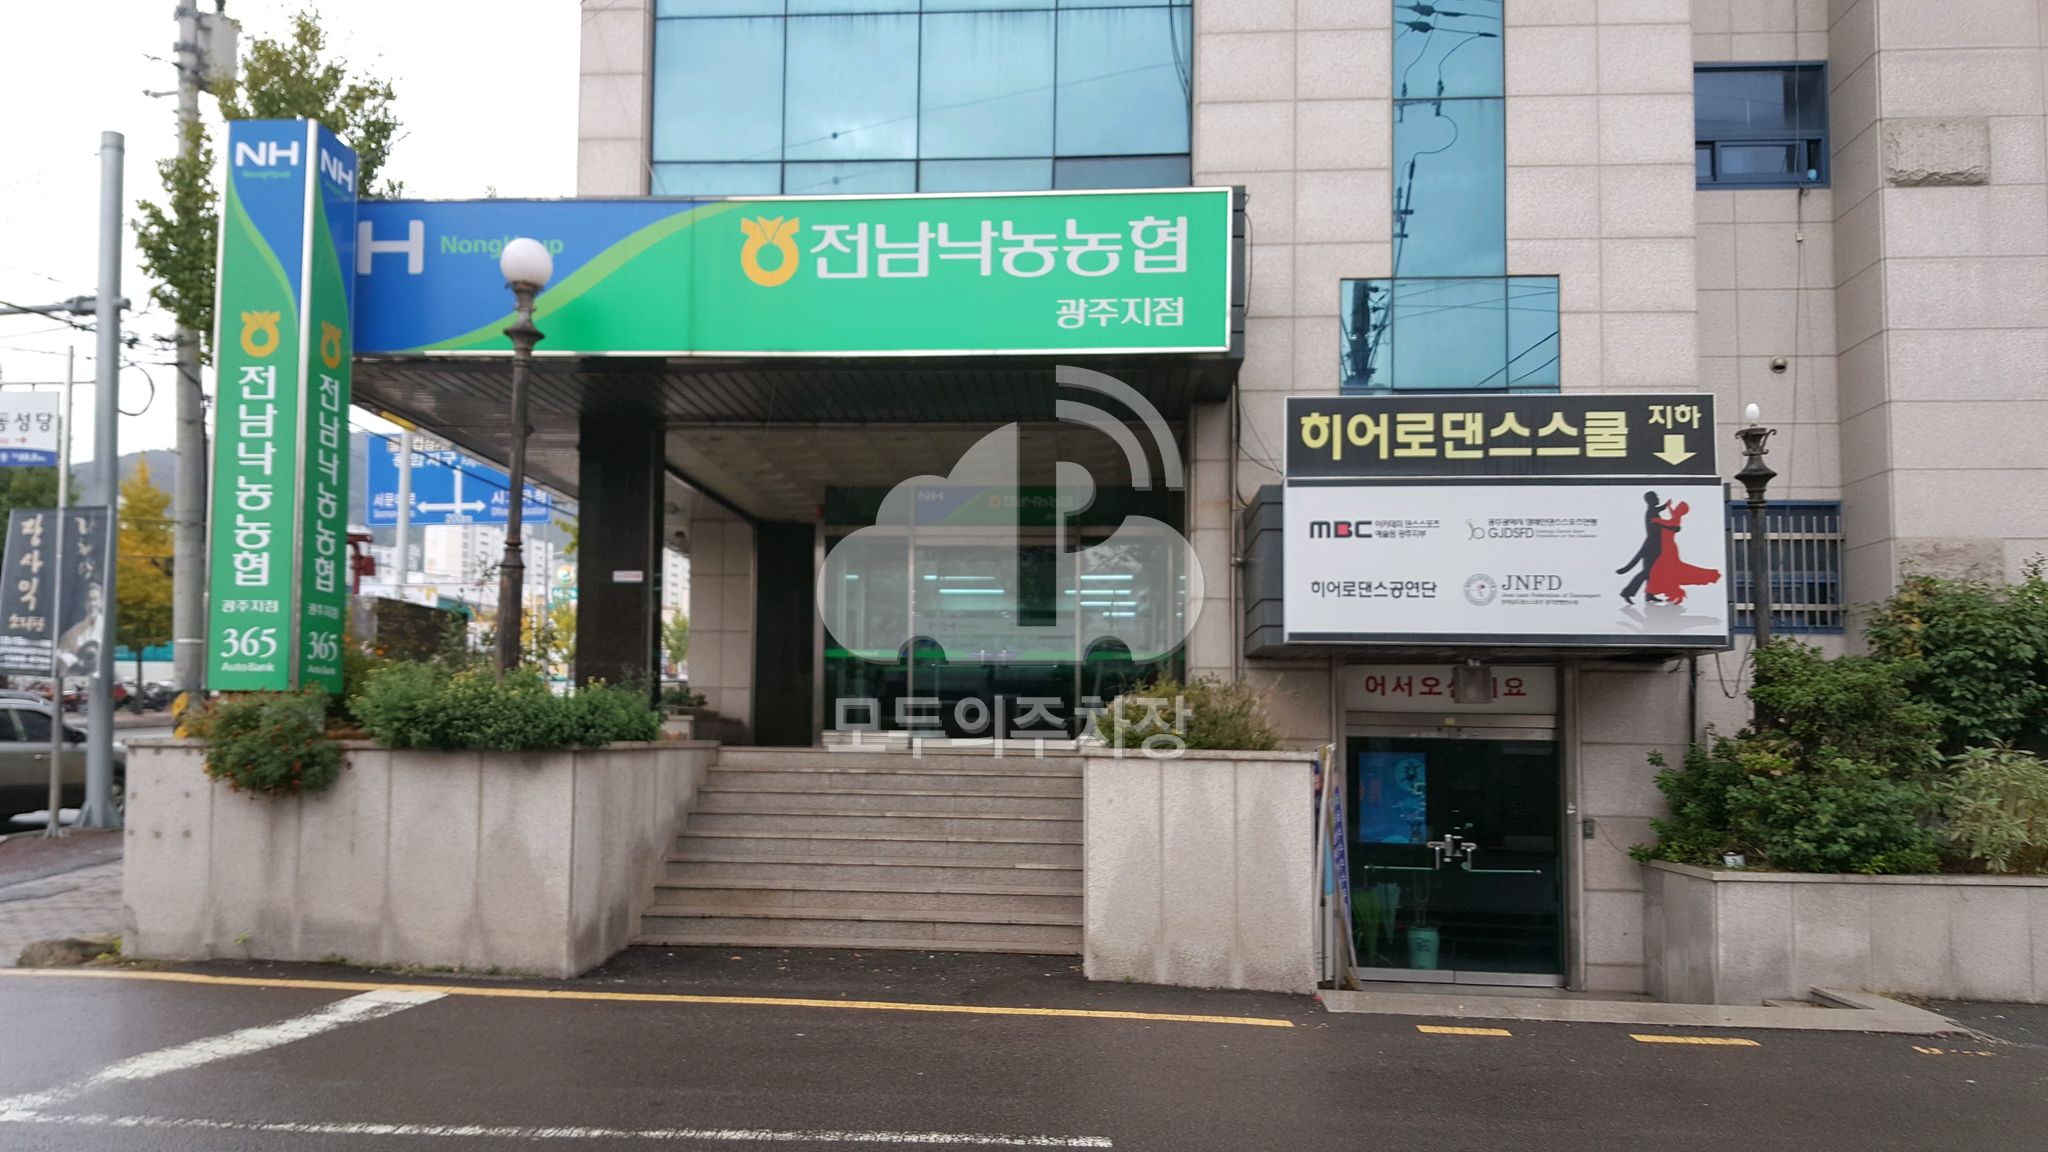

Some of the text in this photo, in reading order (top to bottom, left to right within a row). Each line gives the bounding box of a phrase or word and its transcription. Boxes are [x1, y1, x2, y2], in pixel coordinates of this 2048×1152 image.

[235, 141, 299, 167] NH
[320, 148, 354, 193] NH
[440, 235, 564, 259] Nongp
[810, 214, 1188, 279] 전남낙농농협
[1056, 296, 1185, 329] 광주지점
[1300, 404, 1702, 461] 히어로댄스스쿨 지하
[232, 364, 278, 587] 전남낙농농협
[314, 373, 341, 593] 전남낙농농협
[1310, 580, 1438, 599] 히어로댄스공연단
[1502, 574, 1562, 590] JNFD
[221, 600, 279, 613] 광주지점
[220, 626, 277, 658] 365
[307, 630, 338, 661] 365
[1364, 675, 1527, 698] 어서오요
